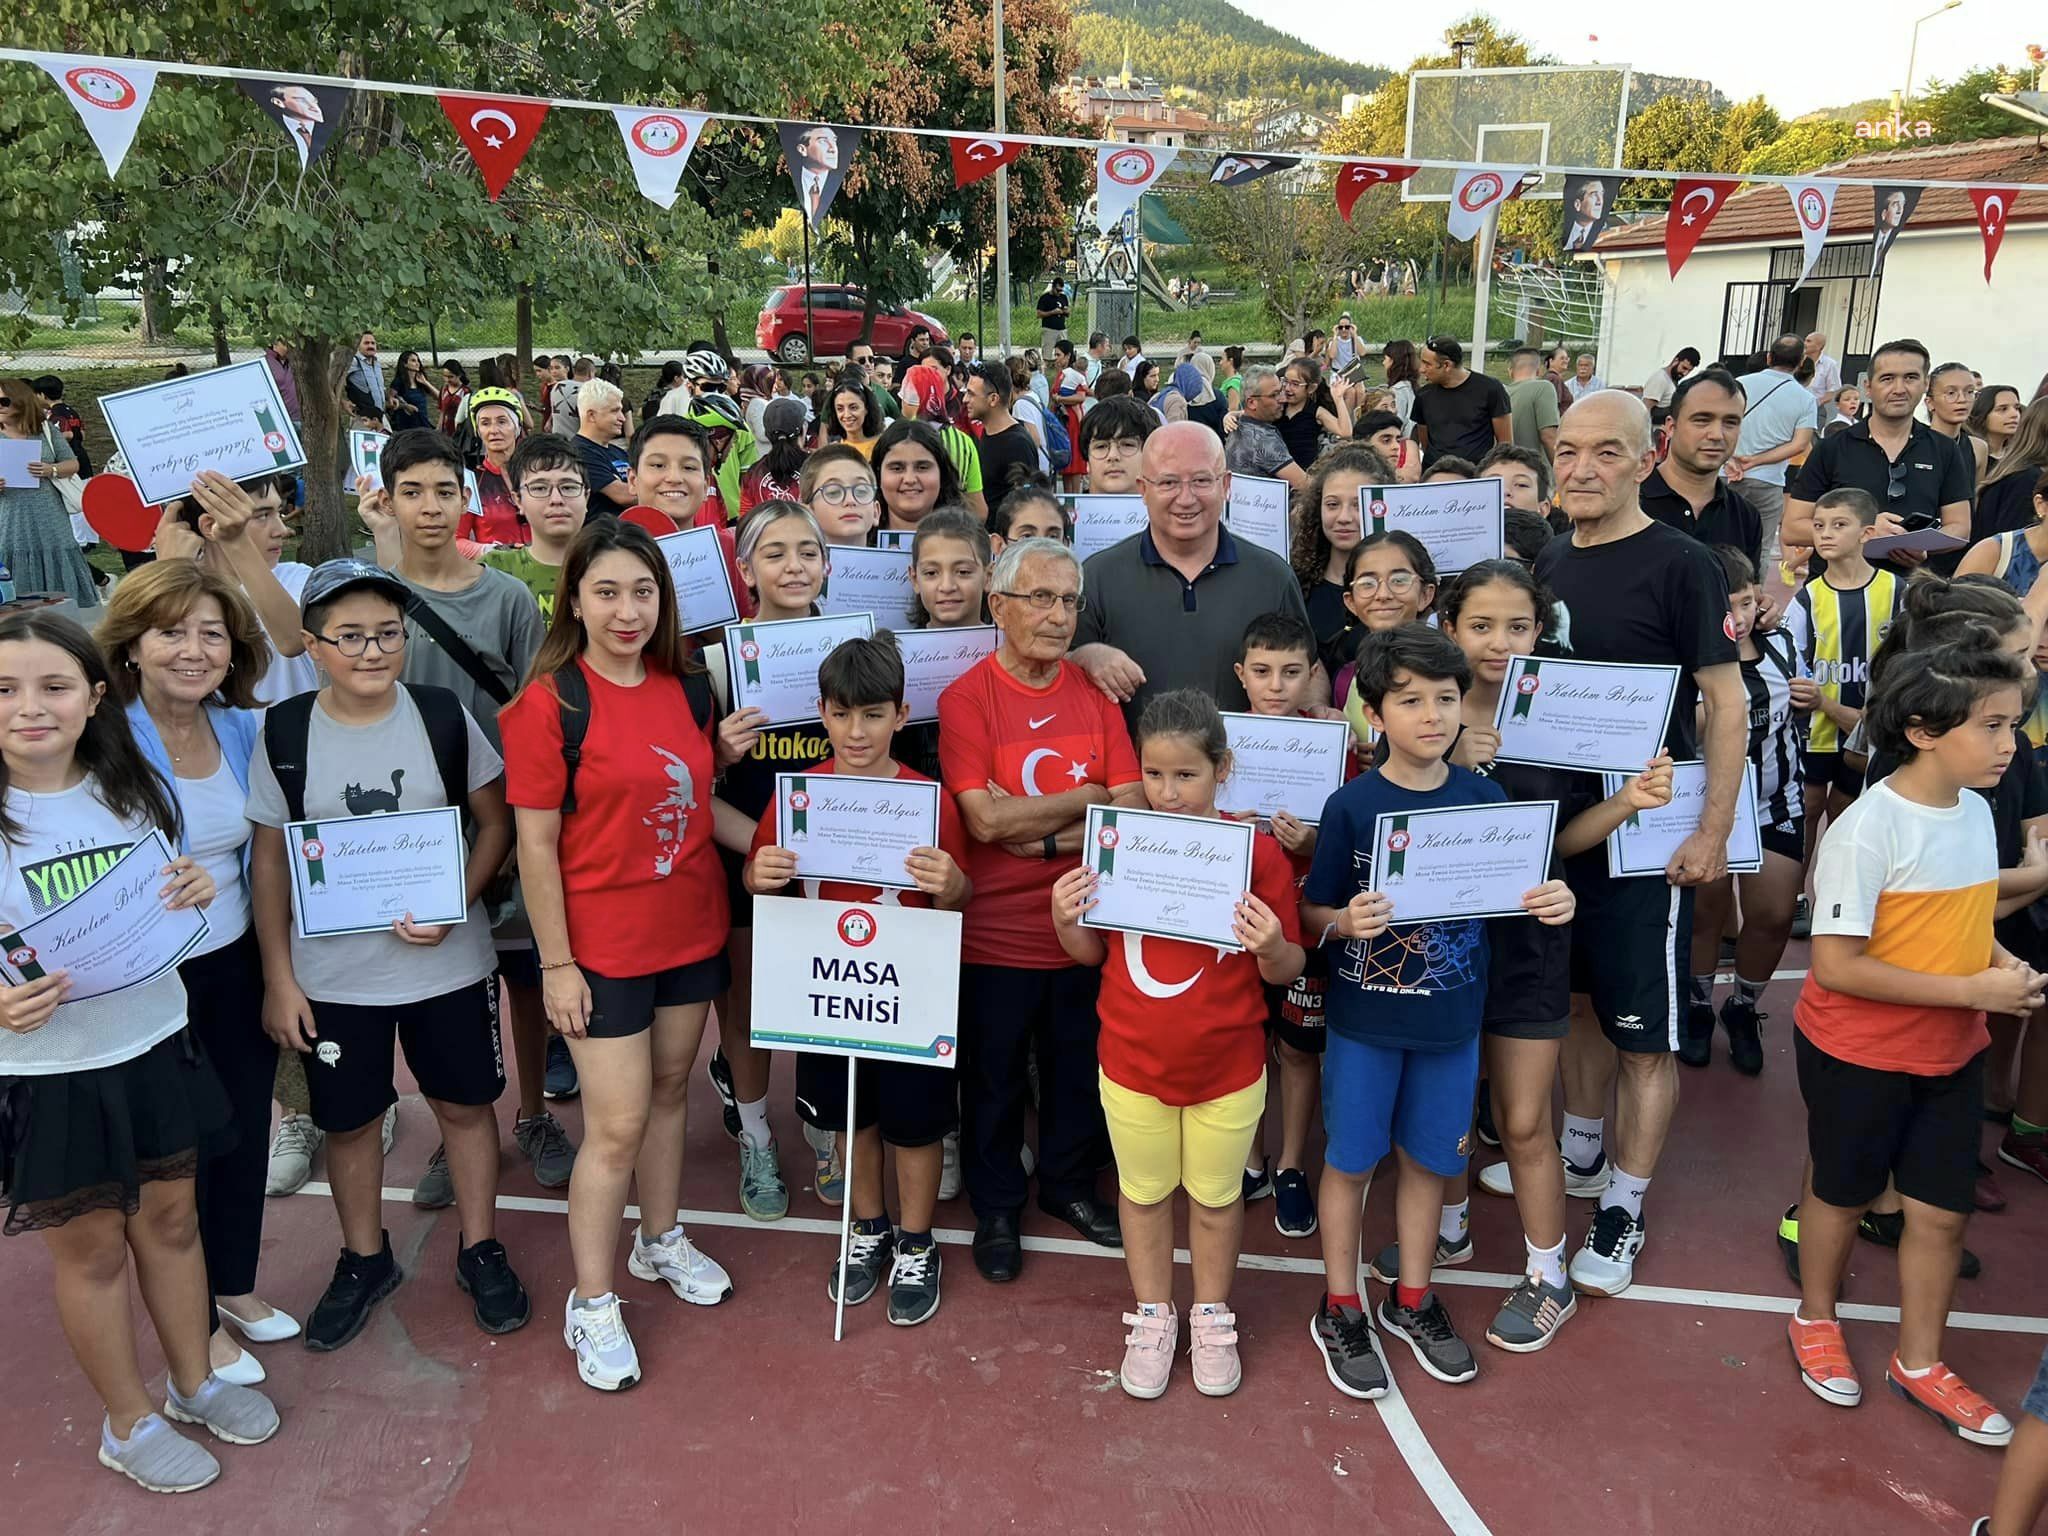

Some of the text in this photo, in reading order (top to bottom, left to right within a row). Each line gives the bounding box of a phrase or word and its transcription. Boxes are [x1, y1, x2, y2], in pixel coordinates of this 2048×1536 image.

[1443, 499, 1488, 516] Belgesi
[1815, 656, 1868, 686] Otok
[1604, 685, 1657, 707] Belgesi
[873, 799, 921, 821] Belgesi
[56, 836, 96, 854] STAY
[392, 833, 444, 853] Belgesi
[1479, 826, 1536, 847] Belgesi
[1183, 841, 1234, 866] Belgesi
[114, 864, 157, 912] Belgesi
[812, 956, 900, 987] MASA
[808, 993, 899, 1025] TENİSİ
